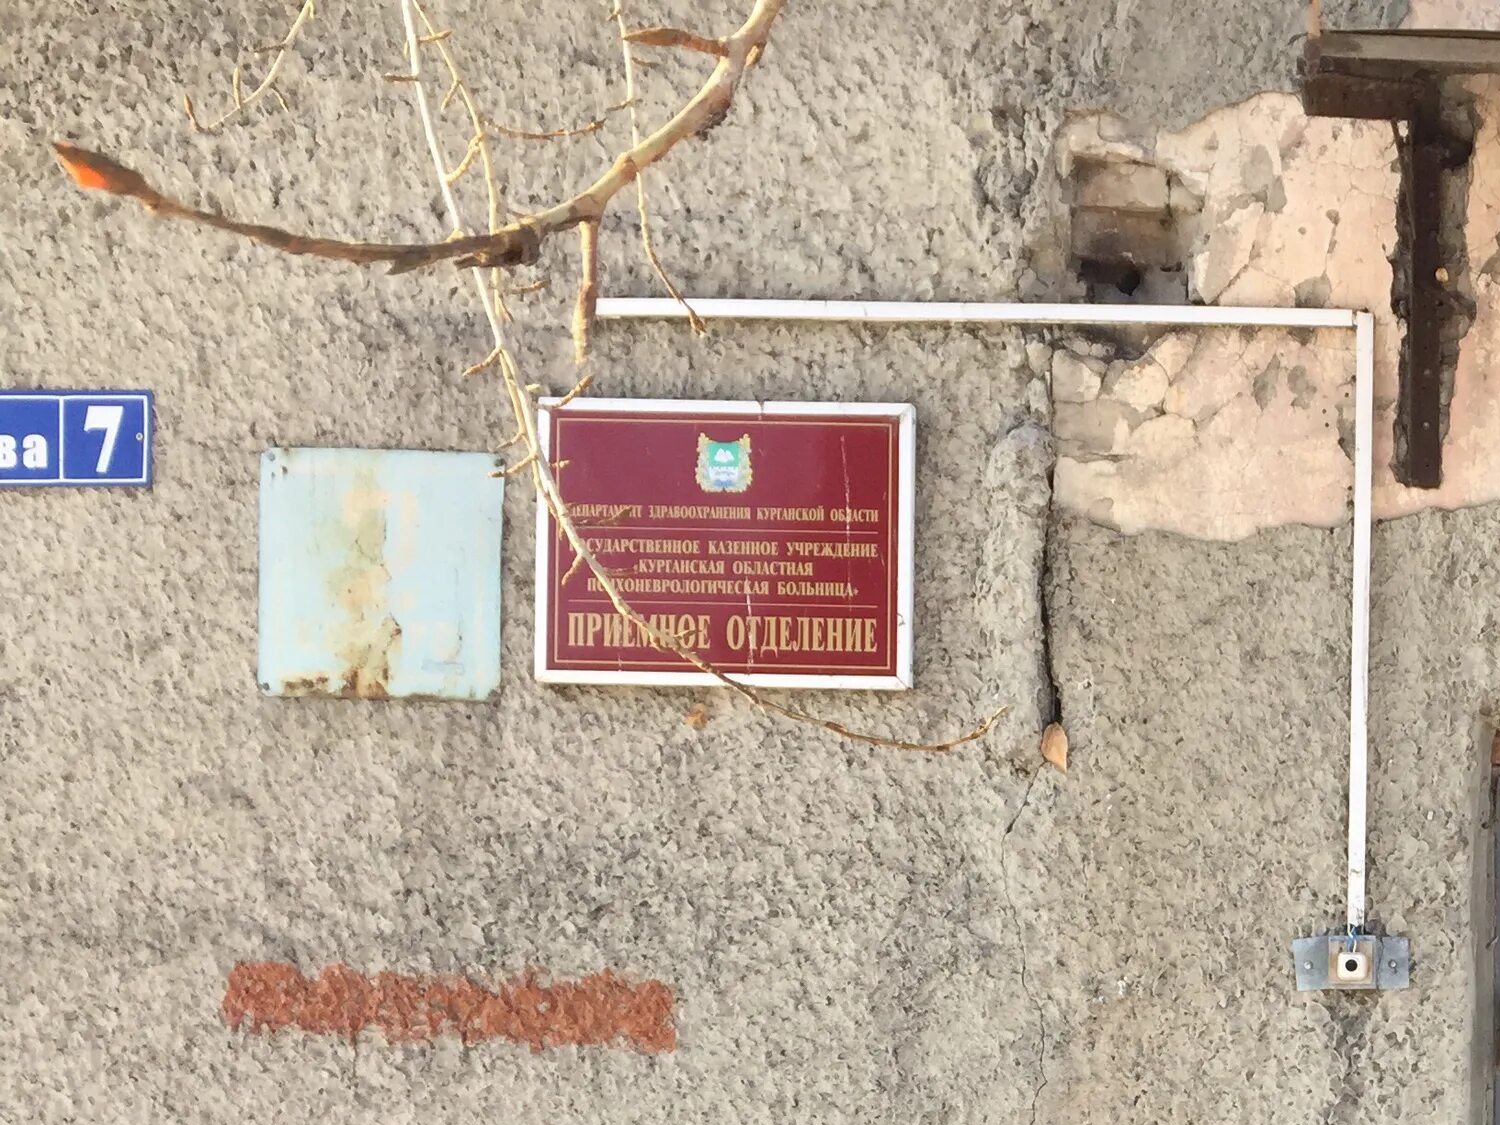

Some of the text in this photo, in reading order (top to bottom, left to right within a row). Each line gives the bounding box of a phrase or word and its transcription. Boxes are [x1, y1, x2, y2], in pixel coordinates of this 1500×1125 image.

[83, 404, 124, 474] 7
[649, 504, 750, 520] ЗДРАВООХРАНЕНИЯ
[757, 505, 824, 522] КУРГАНСКОЙ
[830, 508, 879, 523] ОБЛАСТИ
[708, 540, 779, 556] КАЗЕННОЕ
[786, 542, 879, 559] УЧРЕЖДЕНИЕ
[732, 561, 814, 577] ОБЛАСТНАЯ
[726, 614, 878, 659] ОТДЕЛЕНИЕ
